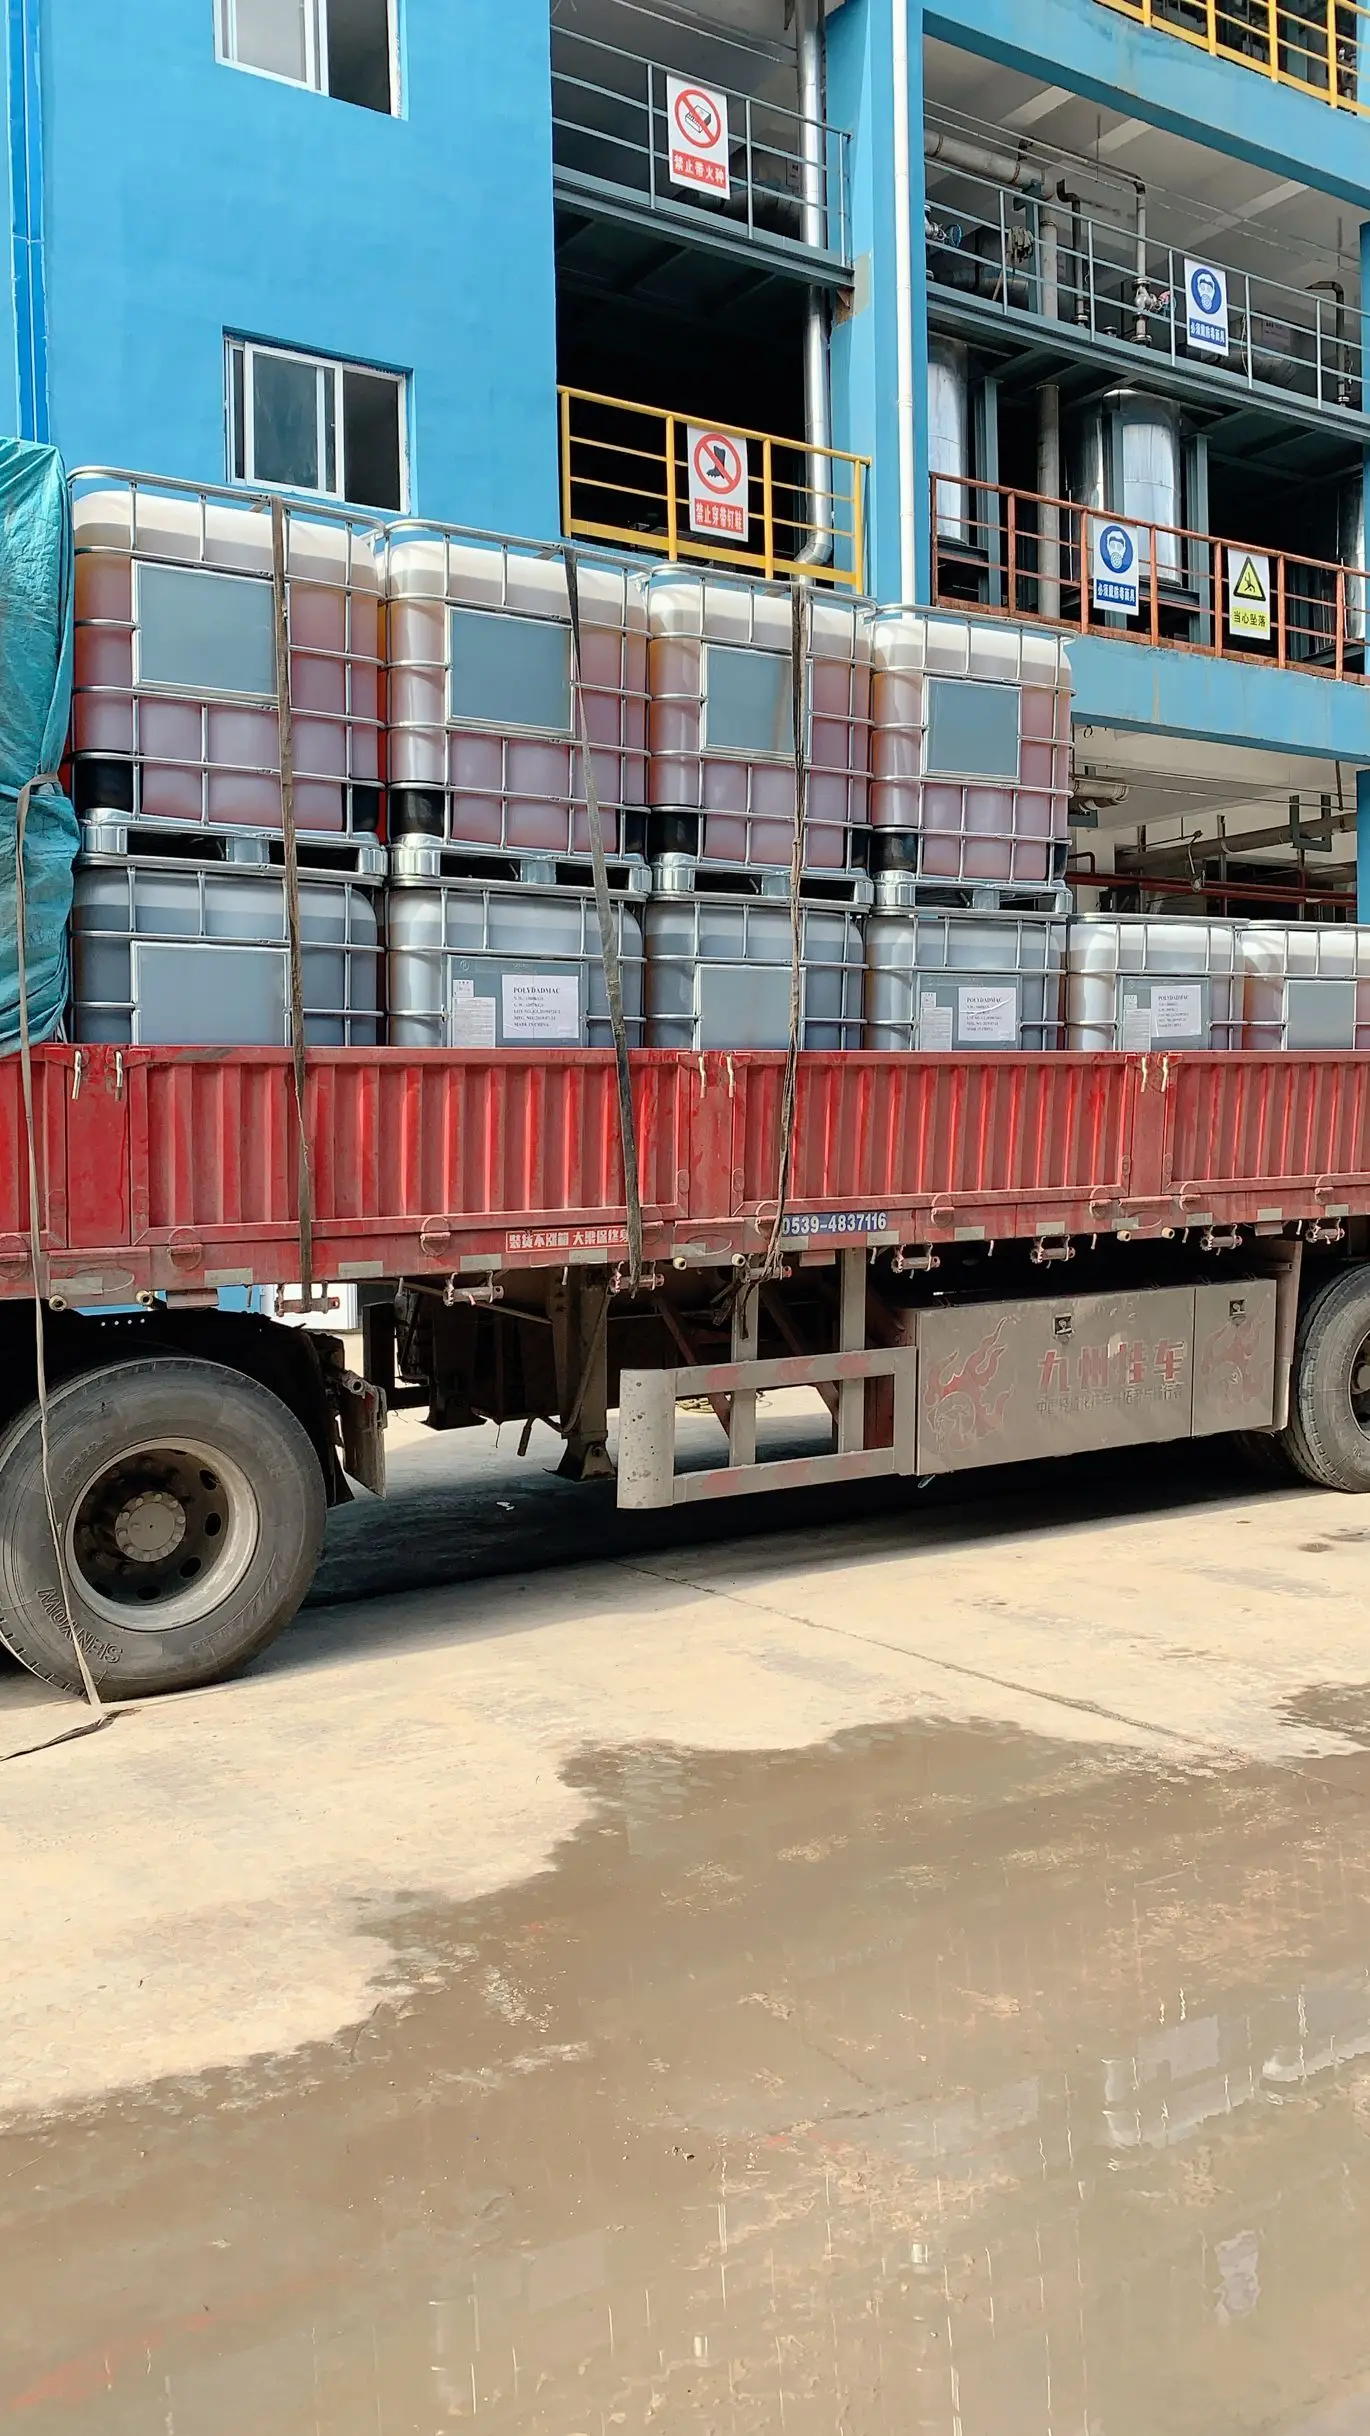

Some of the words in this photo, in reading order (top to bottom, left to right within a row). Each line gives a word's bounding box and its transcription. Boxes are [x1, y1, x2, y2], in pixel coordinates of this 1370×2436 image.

[673, 154, 725, 185] 禁止带火种
[1233, 610, 1266, 628] 当心坠落
[782, 1212, 888, 1235] 0539-4837116
